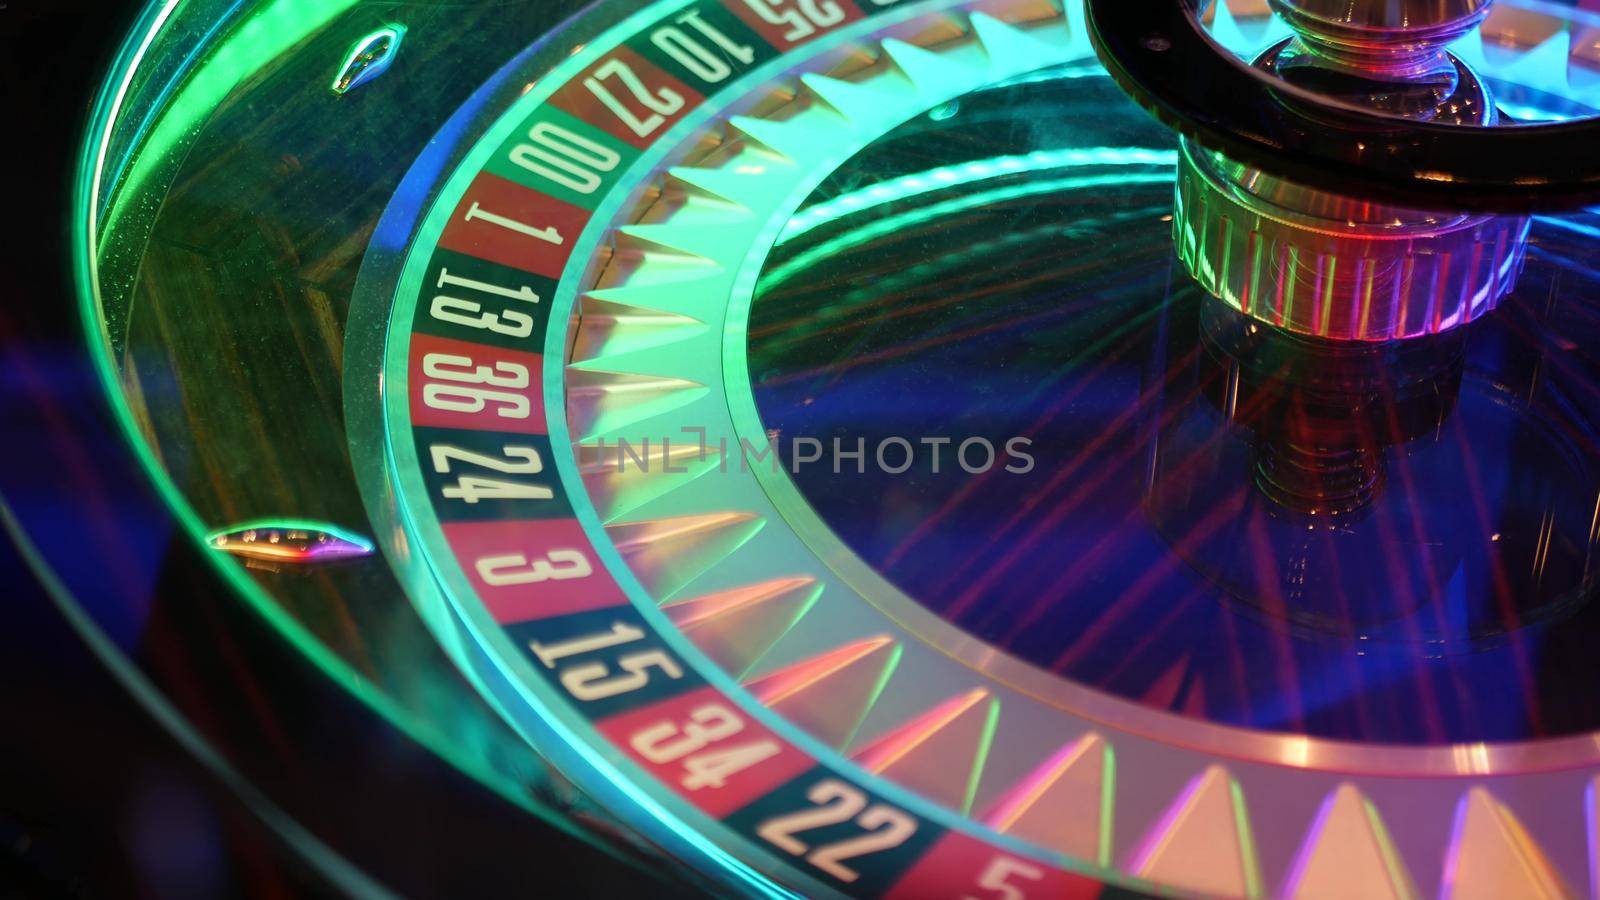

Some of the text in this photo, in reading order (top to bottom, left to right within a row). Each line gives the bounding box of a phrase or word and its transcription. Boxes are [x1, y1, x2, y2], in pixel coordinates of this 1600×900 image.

[650, 8, 755, 83] 10
[583, 58, 686, 138] 27
[508, 121, 621, 194] 00
[464, 201, 565, 246] 1
[429, 267, 540, 339] 13
[422, 352, 531, 419] 36
[428, 445, 554, 504] 24
[474, 549, 594, 587] 3
[529, 621, 683, 701] 15
[628, 703, 782, 792] 34
[757, 777, 918, 883] 22
